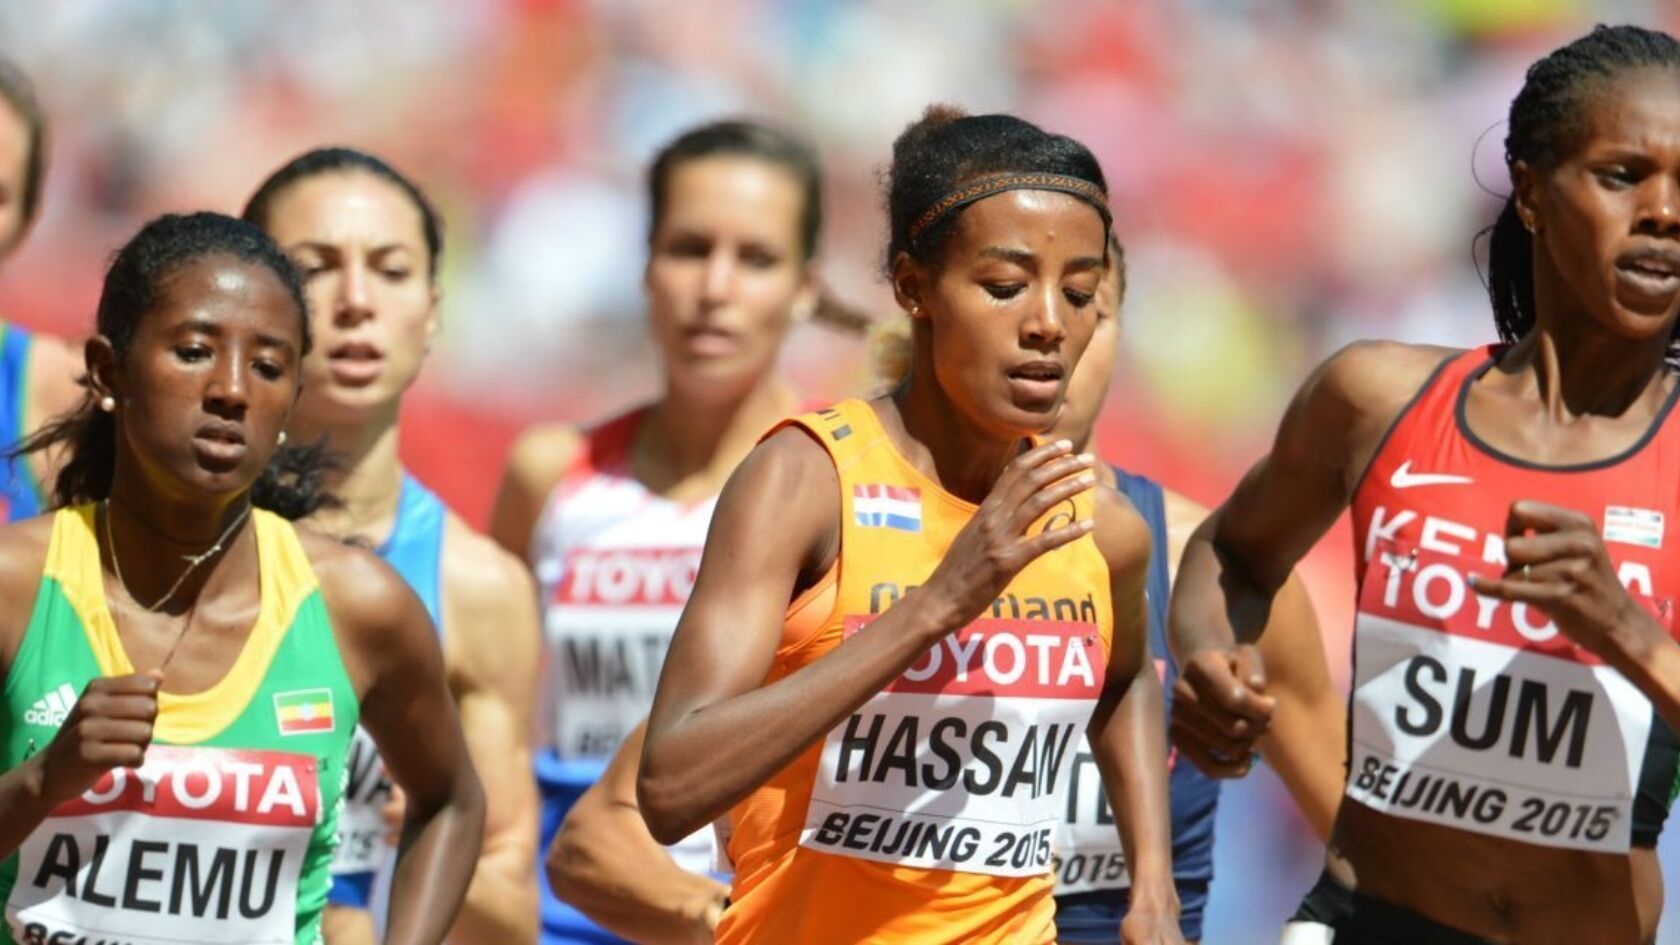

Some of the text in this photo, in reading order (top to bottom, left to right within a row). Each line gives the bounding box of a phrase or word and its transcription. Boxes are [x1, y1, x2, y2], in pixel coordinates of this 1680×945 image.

[570, 555, 700, 601] TOYO
[1380, 551, 1559, 642] TOYO
[902, 632, 1095, 687] OYOTA
[1395, 654, 1594, 768] SUM
[82, 757, 307, 817] OYOTA
[835, 714, 1075, 800] HASSAN
[1356, 756, 1617, 841] BEIJING 2015
[33, 832, 286, 920] ALEMU
[815, 811, 1051, 869] BEIJING 2015
